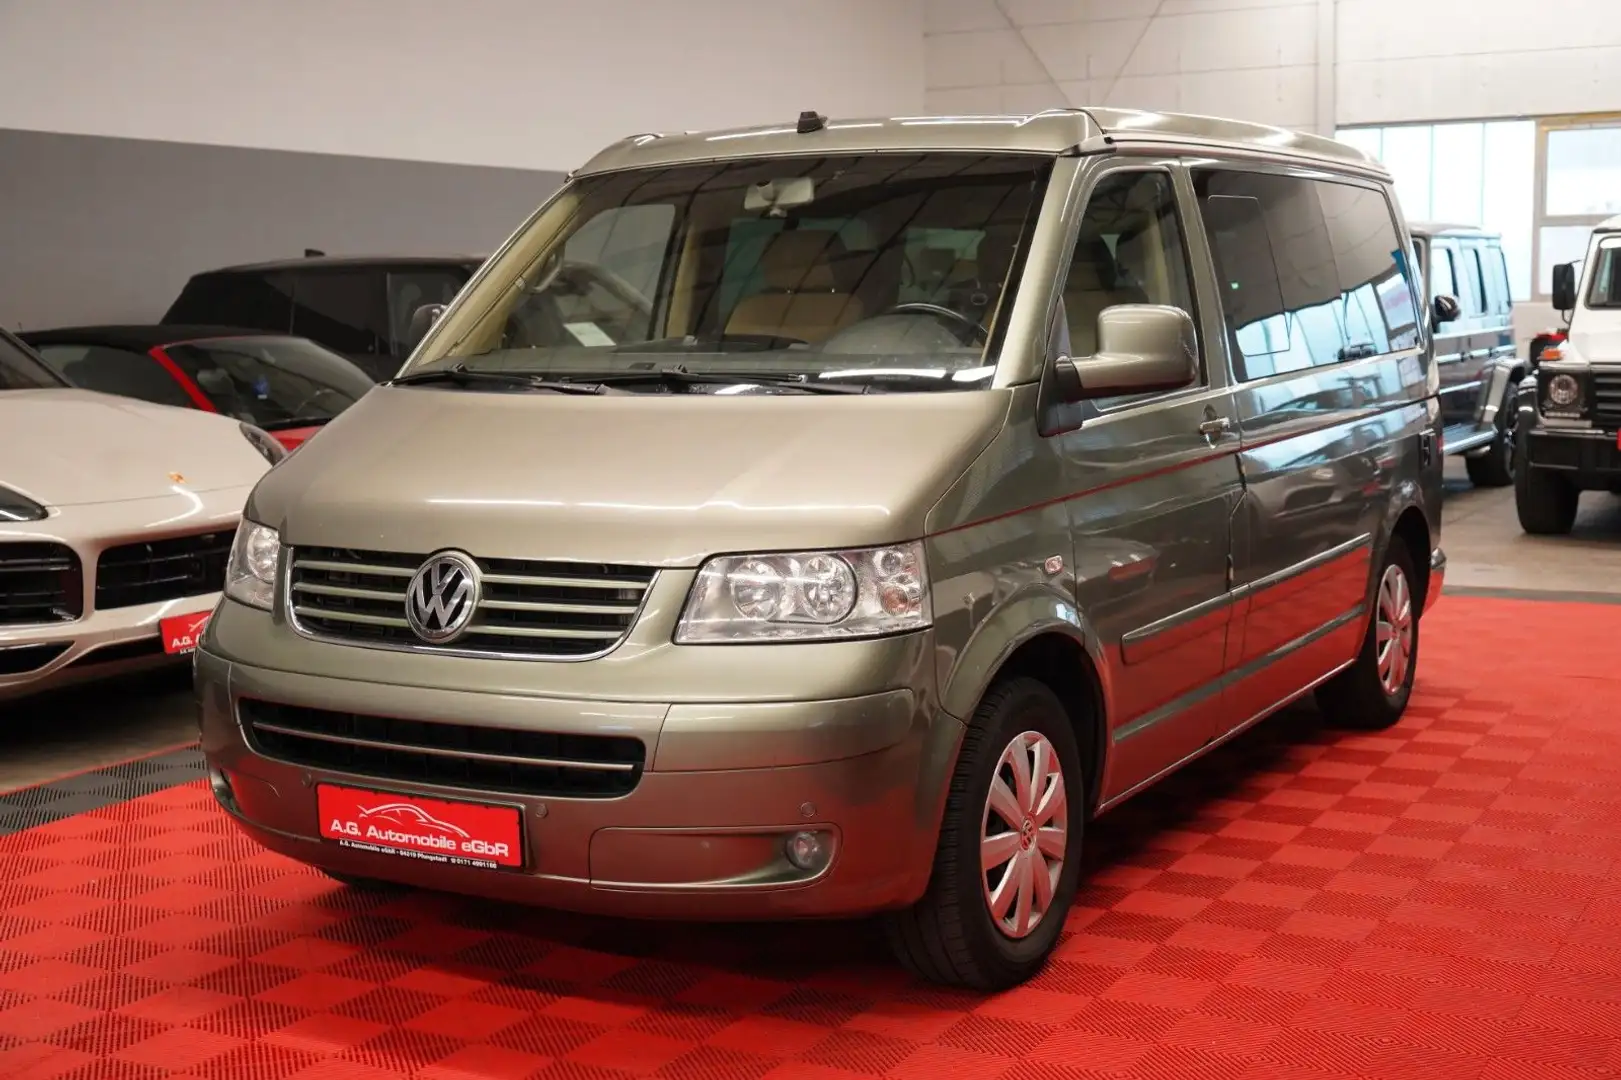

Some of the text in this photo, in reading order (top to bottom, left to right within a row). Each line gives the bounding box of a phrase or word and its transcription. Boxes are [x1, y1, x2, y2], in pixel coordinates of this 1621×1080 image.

[411, 557, 475, 633] VW
[330, 820, 509, 857] A.G. Automobile eGbR
[351, 842, 380, 852] Automobile
